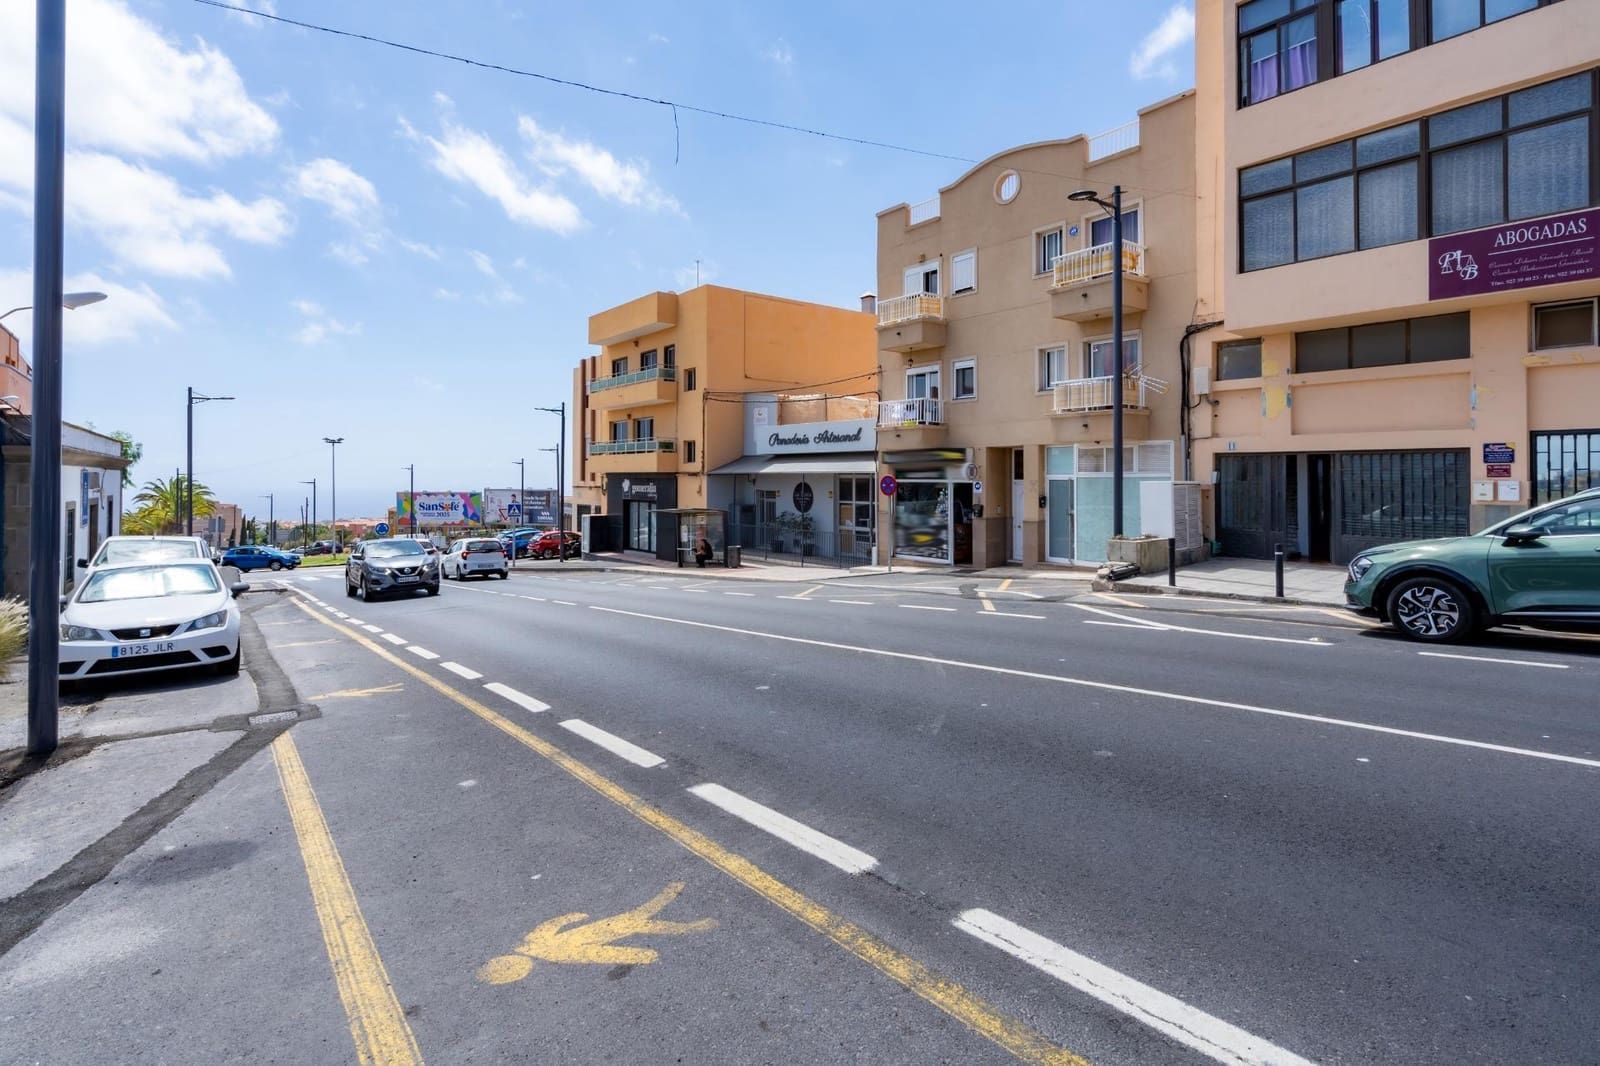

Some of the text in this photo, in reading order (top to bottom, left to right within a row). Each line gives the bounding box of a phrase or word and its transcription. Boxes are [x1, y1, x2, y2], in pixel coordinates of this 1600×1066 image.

[1494, 217, 1587, 248] ABOGADAS
[813, 427, 862, 444] Artesanal
[120, 642, 174, 656] 8125 JLR
